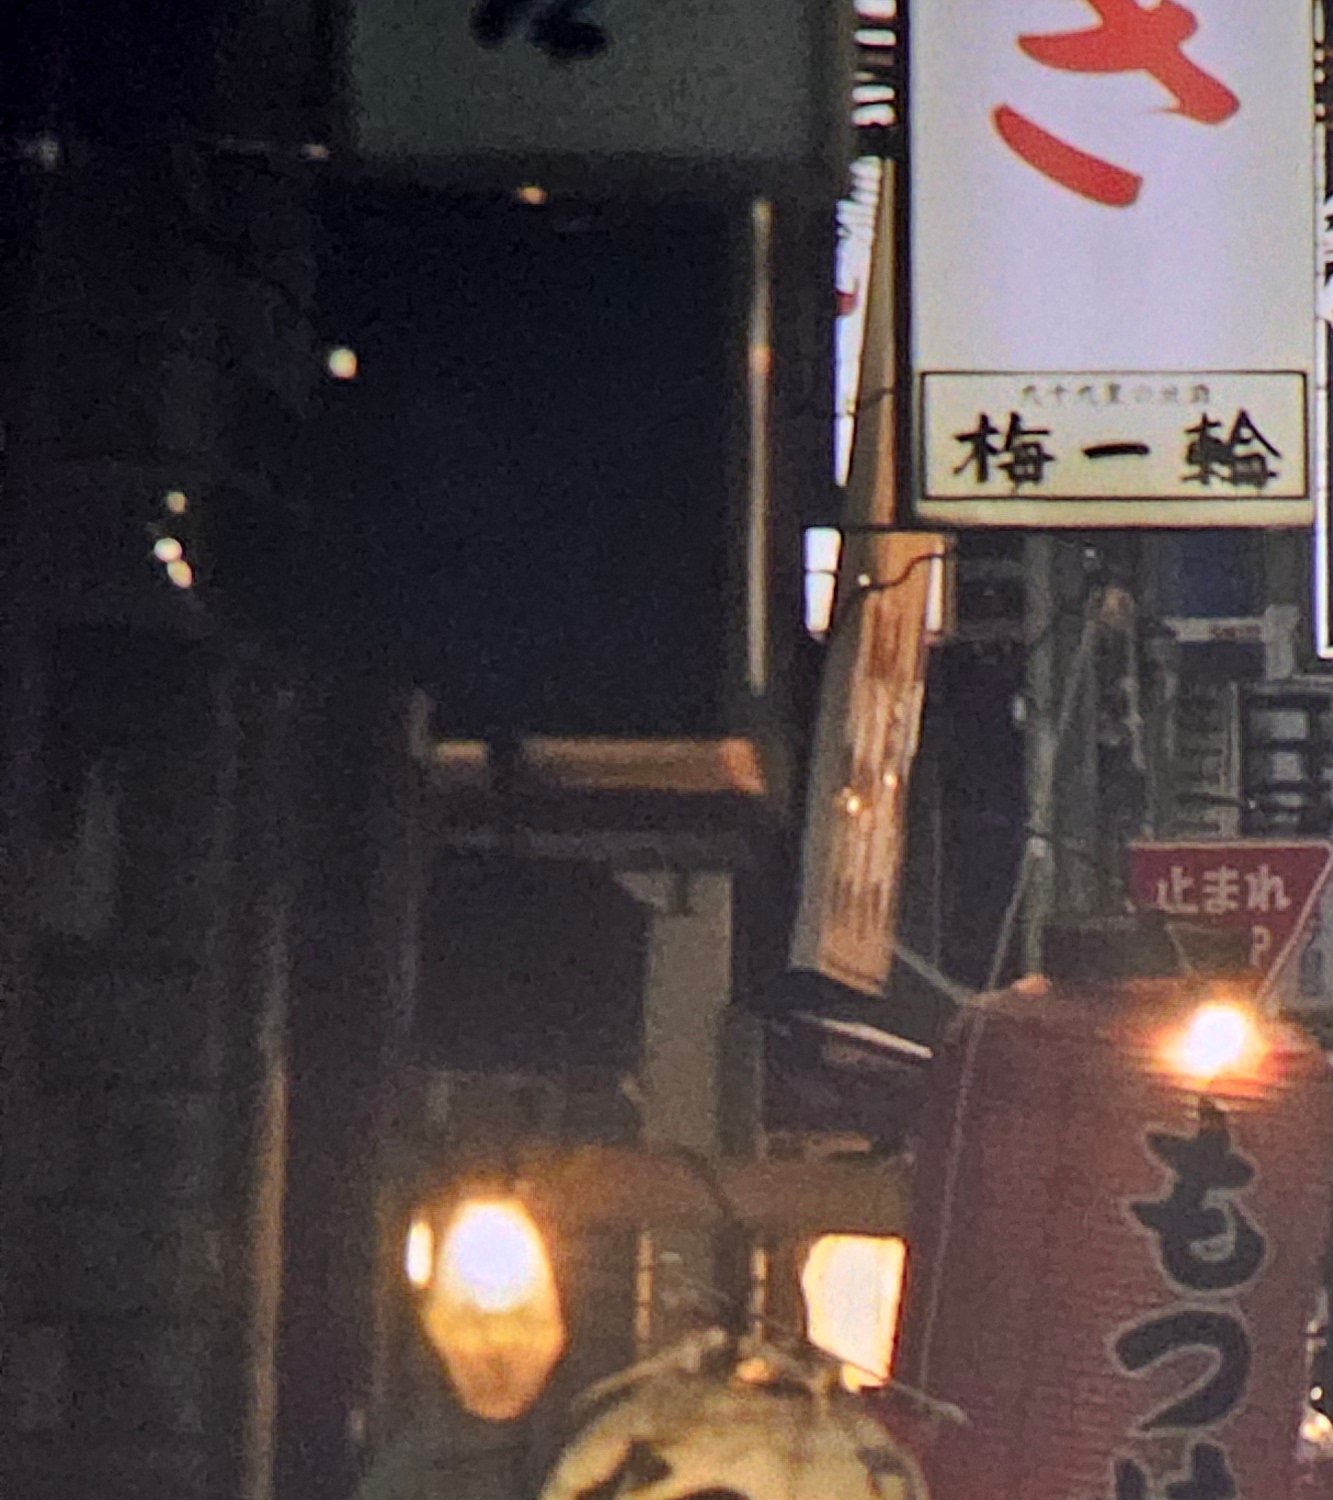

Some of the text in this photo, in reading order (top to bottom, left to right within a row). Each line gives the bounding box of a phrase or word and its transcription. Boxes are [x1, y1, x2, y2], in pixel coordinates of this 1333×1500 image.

[953, 410, 1282, 491] 梅一輪
[1156, 864, 1289, 914] 止まれ
